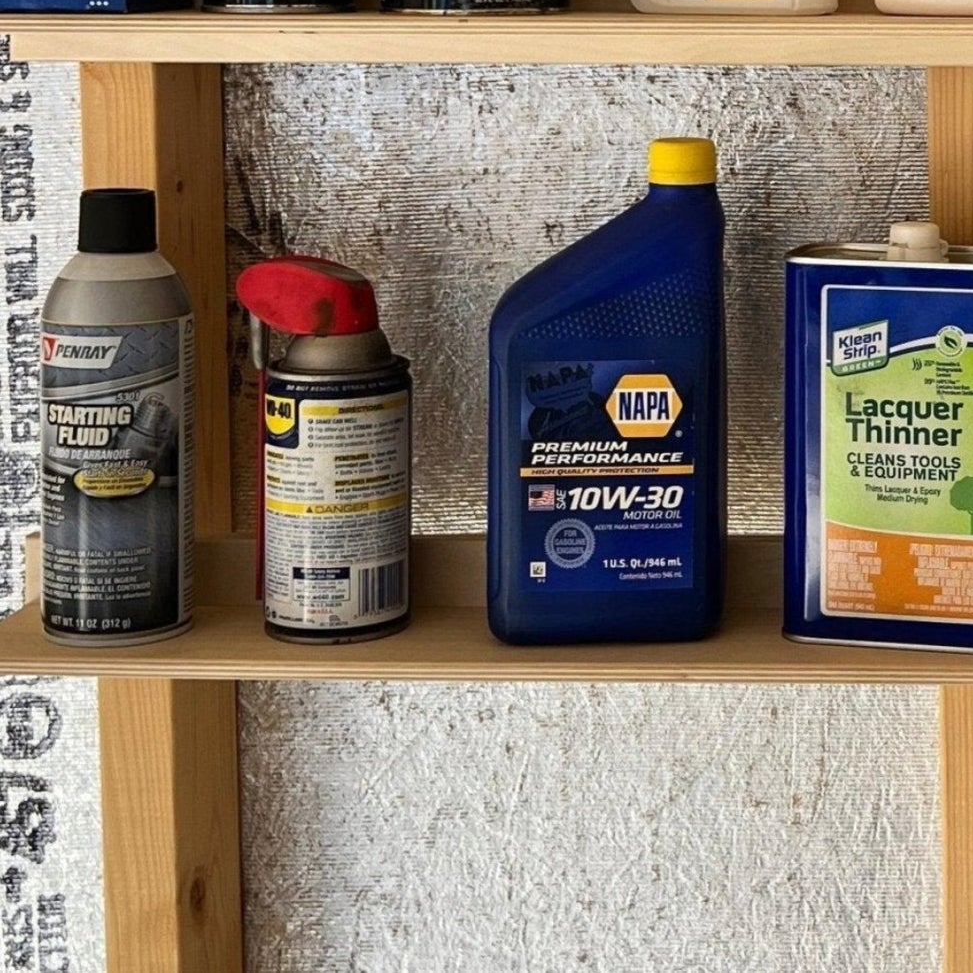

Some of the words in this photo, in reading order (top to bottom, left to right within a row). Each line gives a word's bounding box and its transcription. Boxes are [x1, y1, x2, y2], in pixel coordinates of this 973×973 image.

[838, 330, 882, 350] Klean
[56, 344, 111, 359] PENRAY
[843, 344, 878, 360] Strip
[619, 392, 670, 420] NAPA
[845, 392, 963, 425] Lacquer
[48, 404, 132, 425] STARTING
[58, 426, 110, 446] FLUID
[845, 418, 962, 446] Thinner
[83, 448, 131, 460] ARRANQUE
[531, 442, 628, 453] PREMIUM
[531, 452, 684, 465] PERFORMANCE
[847, 452, 906, 467] CLEANS
[910, 455, 961, 469] TOOLS
[850, 465, 860, 477] &
[865, 466, 958, 481] EQUIPMENT
[556, 489, 566, 509] SAE
[568, 486, 684, 510] 10W-30
[865, 484, 883, 492] Thins
[885, 485, 911, 495] Lacquer
[920, 487, 941, 497] Epoxy
[877, 494, 904, 502] Medium
[906, 494, 928, 505] Drying
[315, 503, 369, 514] DANGER
[623, 511, 664, 520] MOTOR
[665, 510, 682, 519] OIL
[609, 559, 628, 568] U.S.
[667, 557, 682, 566] mL
[51, 615, 61, 625] NET
[87, 619, 97, 628] OZ
[102, 618, 120, 628] (312
[121, 617, 131, 628] g)
